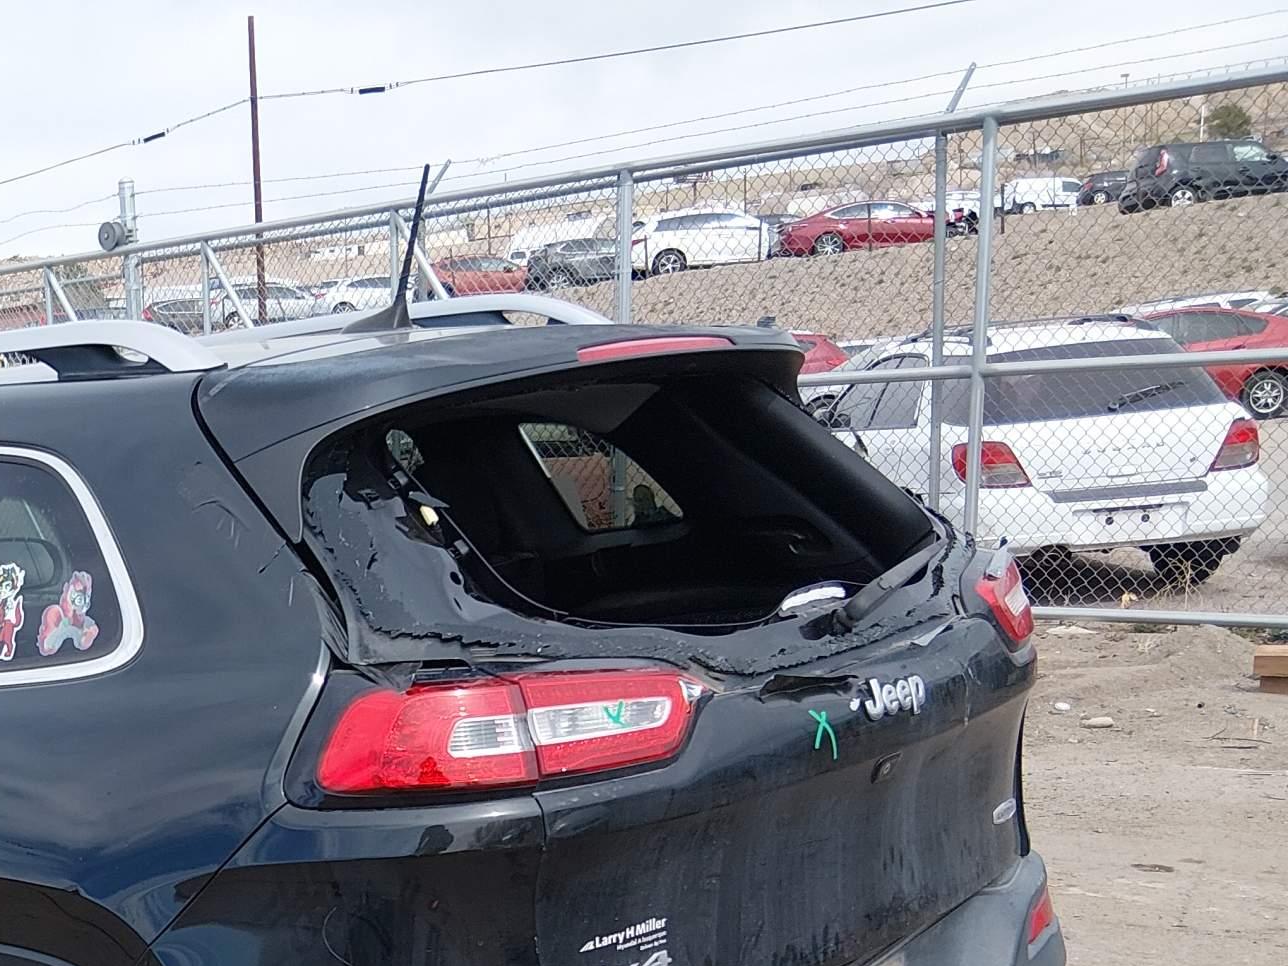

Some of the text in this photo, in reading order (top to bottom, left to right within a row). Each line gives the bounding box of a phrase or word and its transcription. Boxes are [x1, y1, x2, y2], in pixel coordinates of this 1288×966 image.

[864, 675, 926, 720] Jeep
[594, 931, 626, 949] Larry
[625, 926, 635, 939] H
[635, 917, 667, 936] Miller
